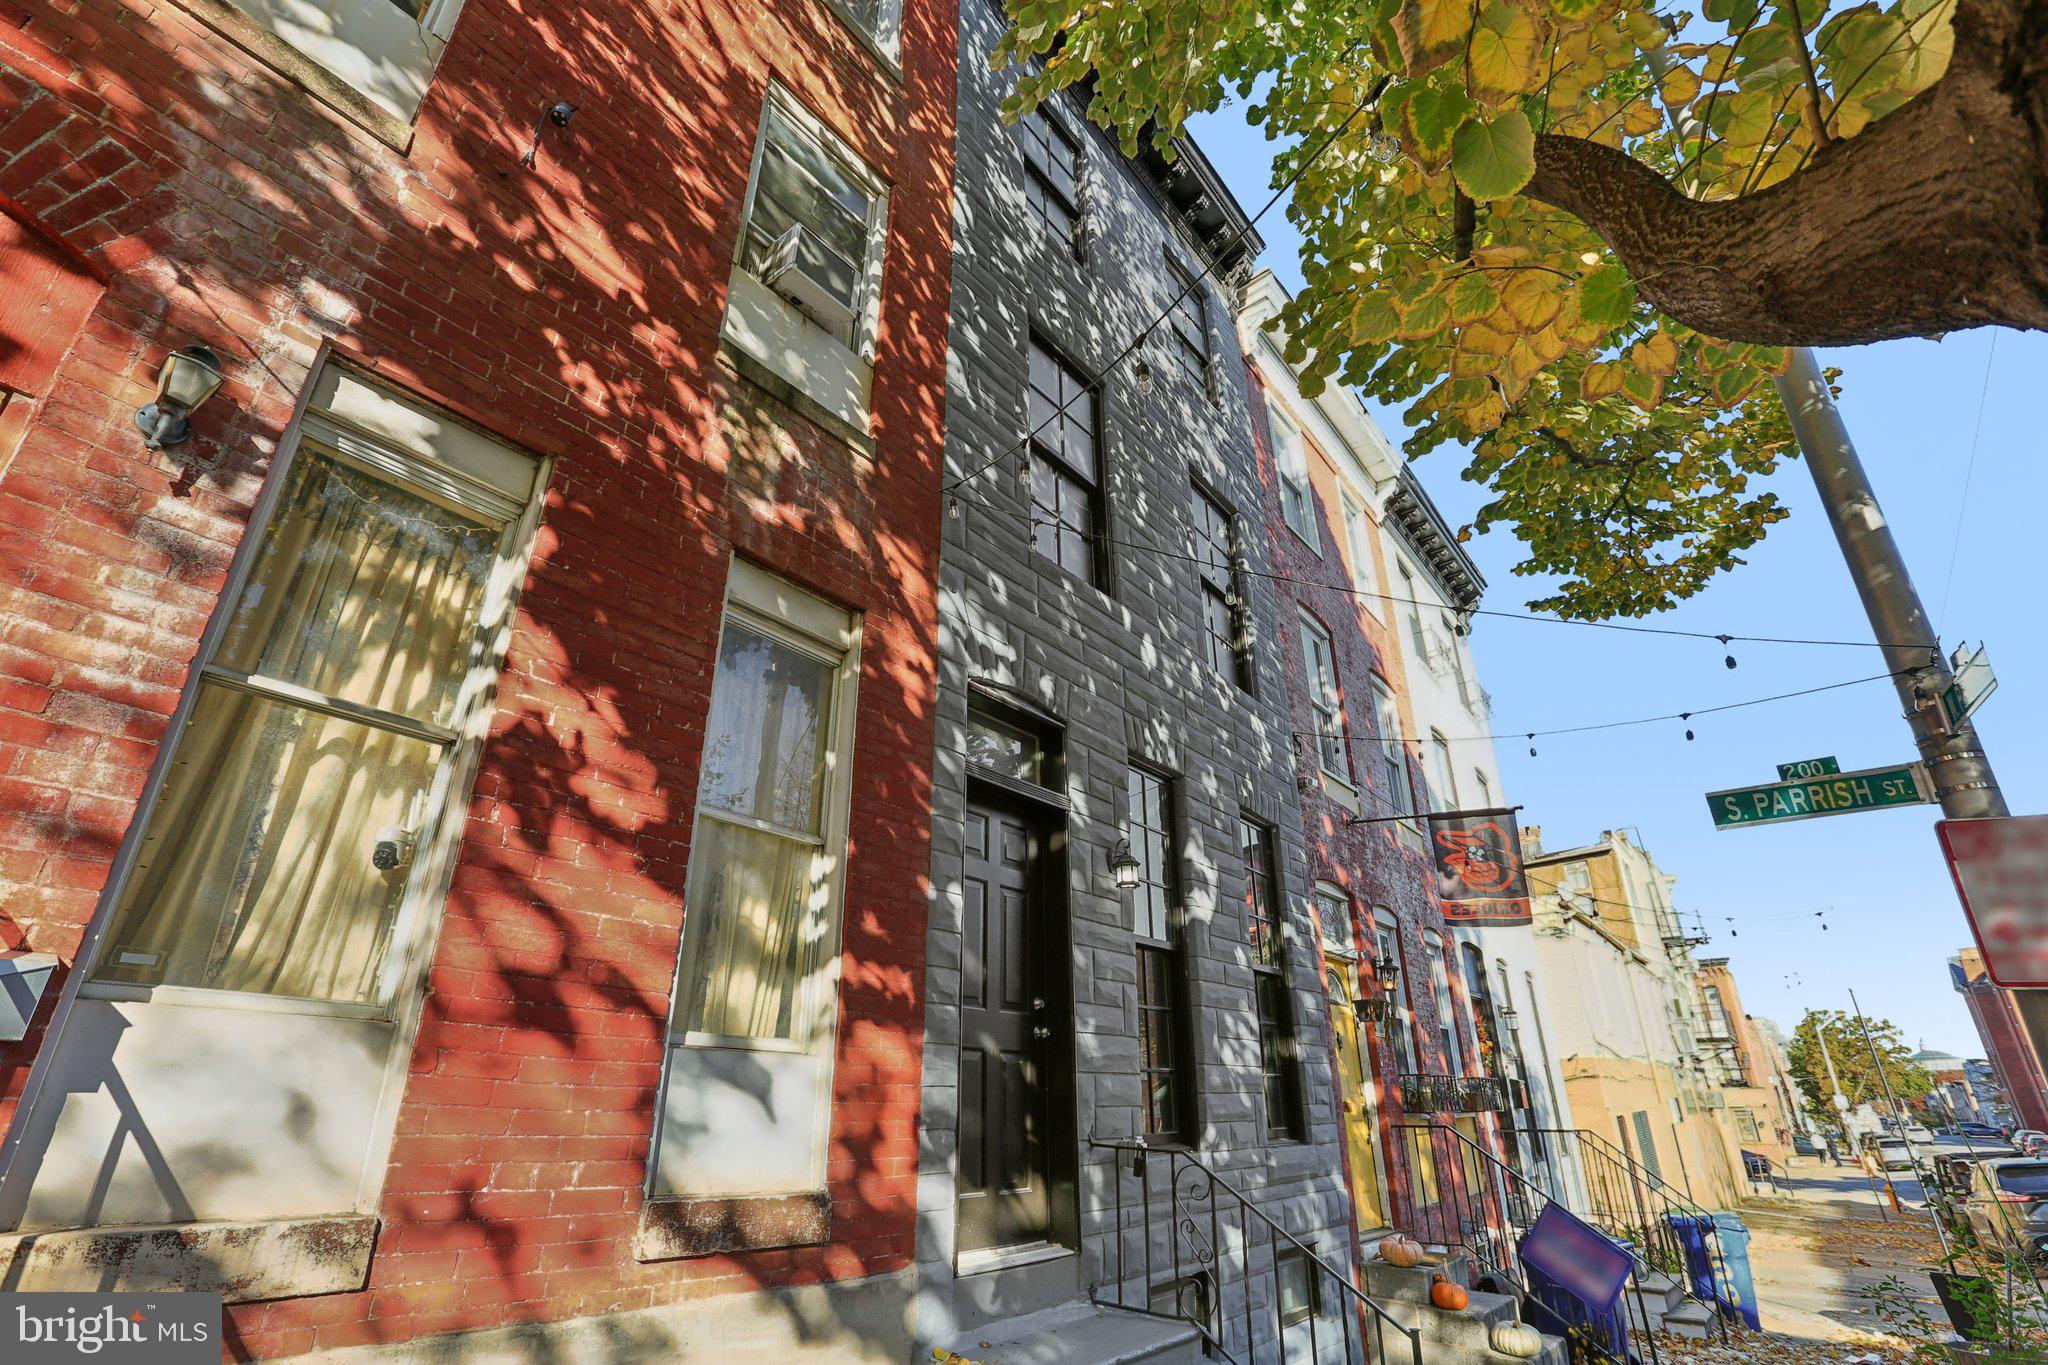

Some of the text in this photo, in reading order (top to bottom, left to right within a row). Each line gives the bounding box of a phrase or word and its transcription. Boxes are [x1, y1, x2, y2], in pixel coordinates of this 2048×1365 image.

[1783, 761, 1824, 780] 200
[1724, 779, 1913, 821] S. PARRISH ST.
